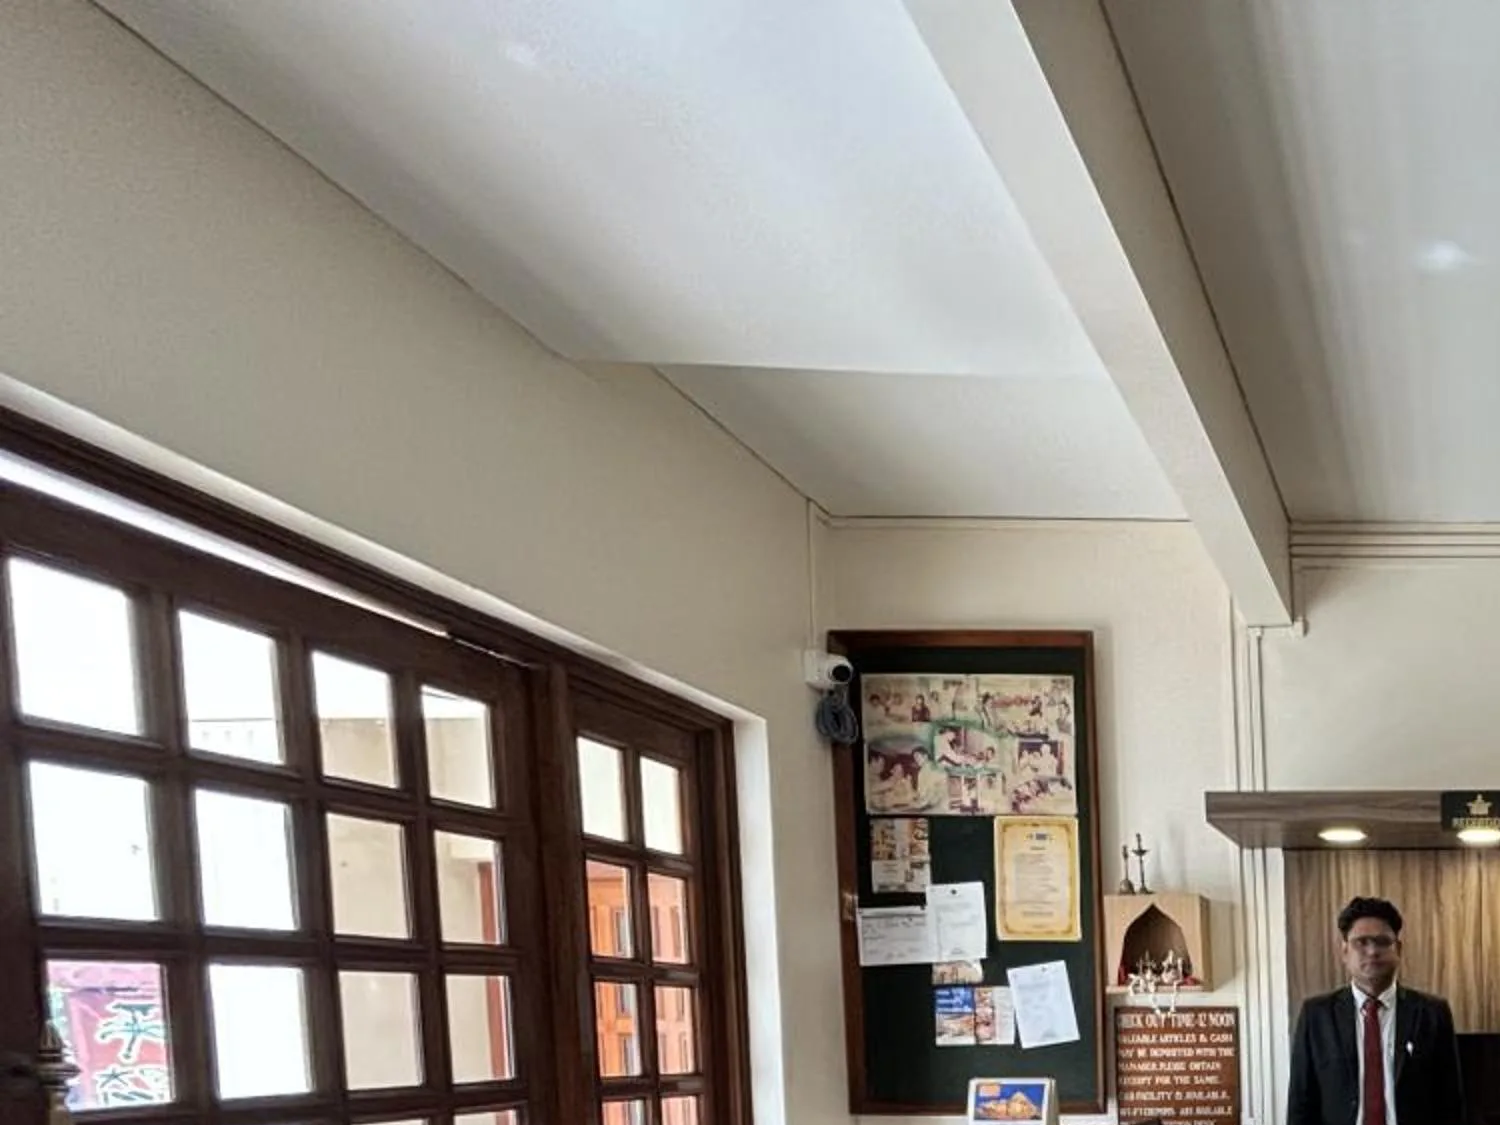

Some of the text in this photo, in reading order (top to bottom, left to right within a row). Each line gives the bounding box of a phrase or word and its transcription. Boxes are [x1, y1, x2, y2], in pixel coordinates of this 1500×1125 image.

[1144, 1013, 1166, 1028] OUT
[1209, 1012, 1235, 1028] NOON
[1209, 1033, 1233, 1044] CASH
[1195, 1047, 1216, 1057] WITH
[1217, 1047, 1235, 1057] THE
[1189, 1061, 1222, 1072] OBTAIN
[1174, 1075, 1190, 1085] THE
